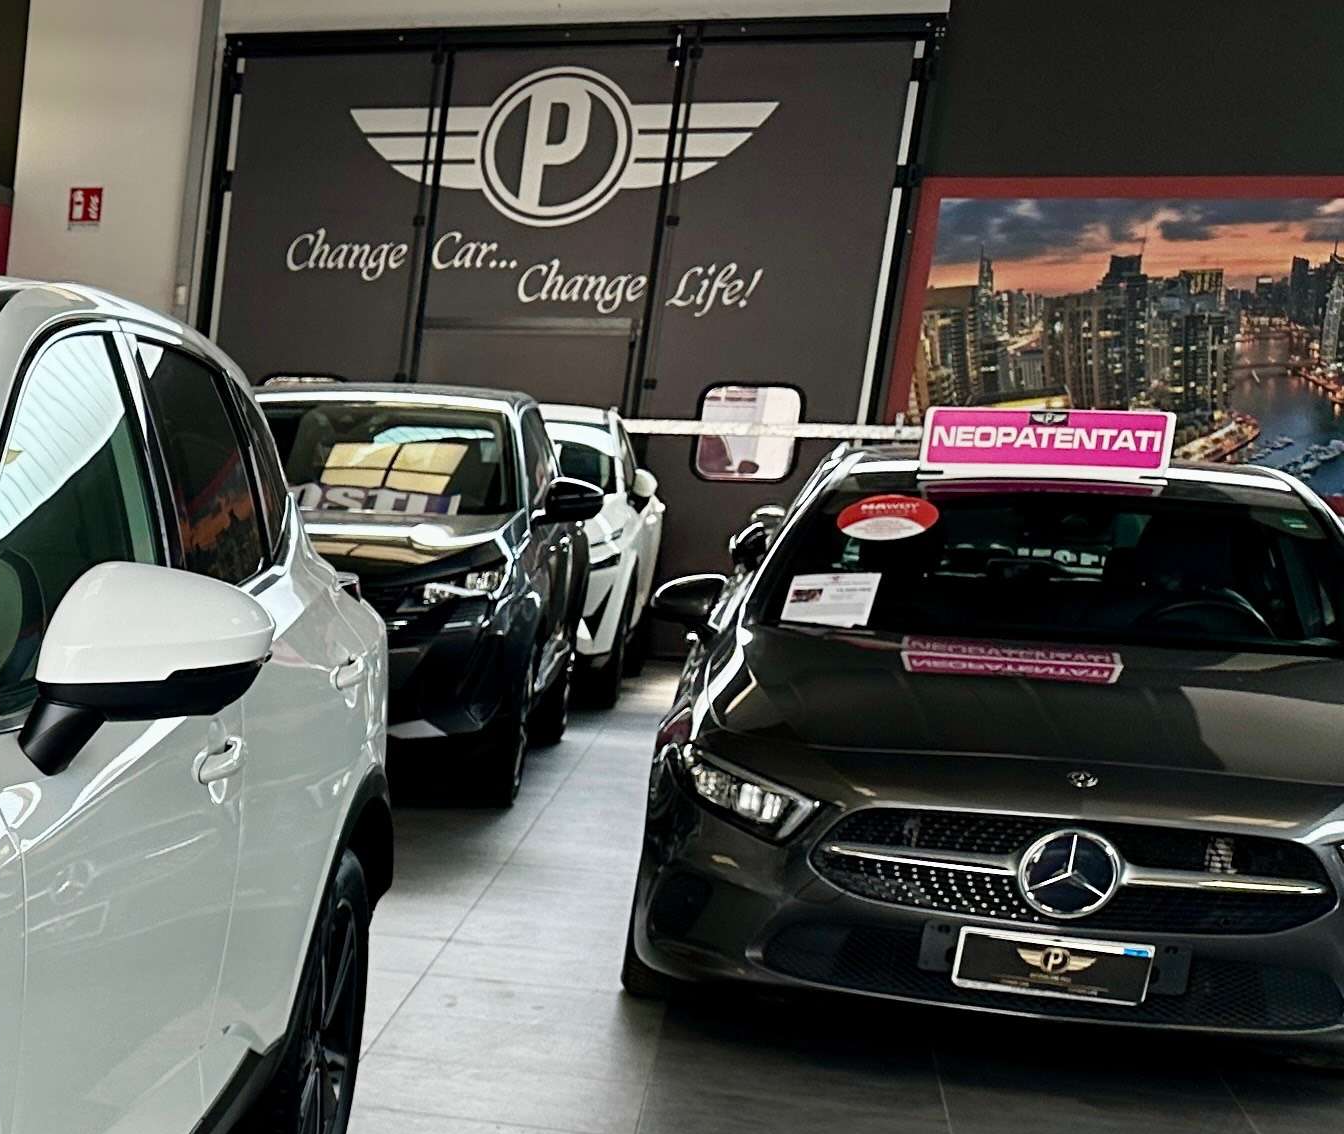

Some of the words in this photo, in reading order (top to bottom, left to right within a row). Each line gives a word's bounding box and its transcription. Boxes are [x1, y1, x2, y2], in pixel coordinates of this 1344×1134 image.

[286, 229, 408, 281] Change
[431, 231, 518, 270] Car...
[517, 259, 647, 314] Change
[665, 262, 764, 318] Life!
[931, 425, 1162, 453] NEOPATENTATI
